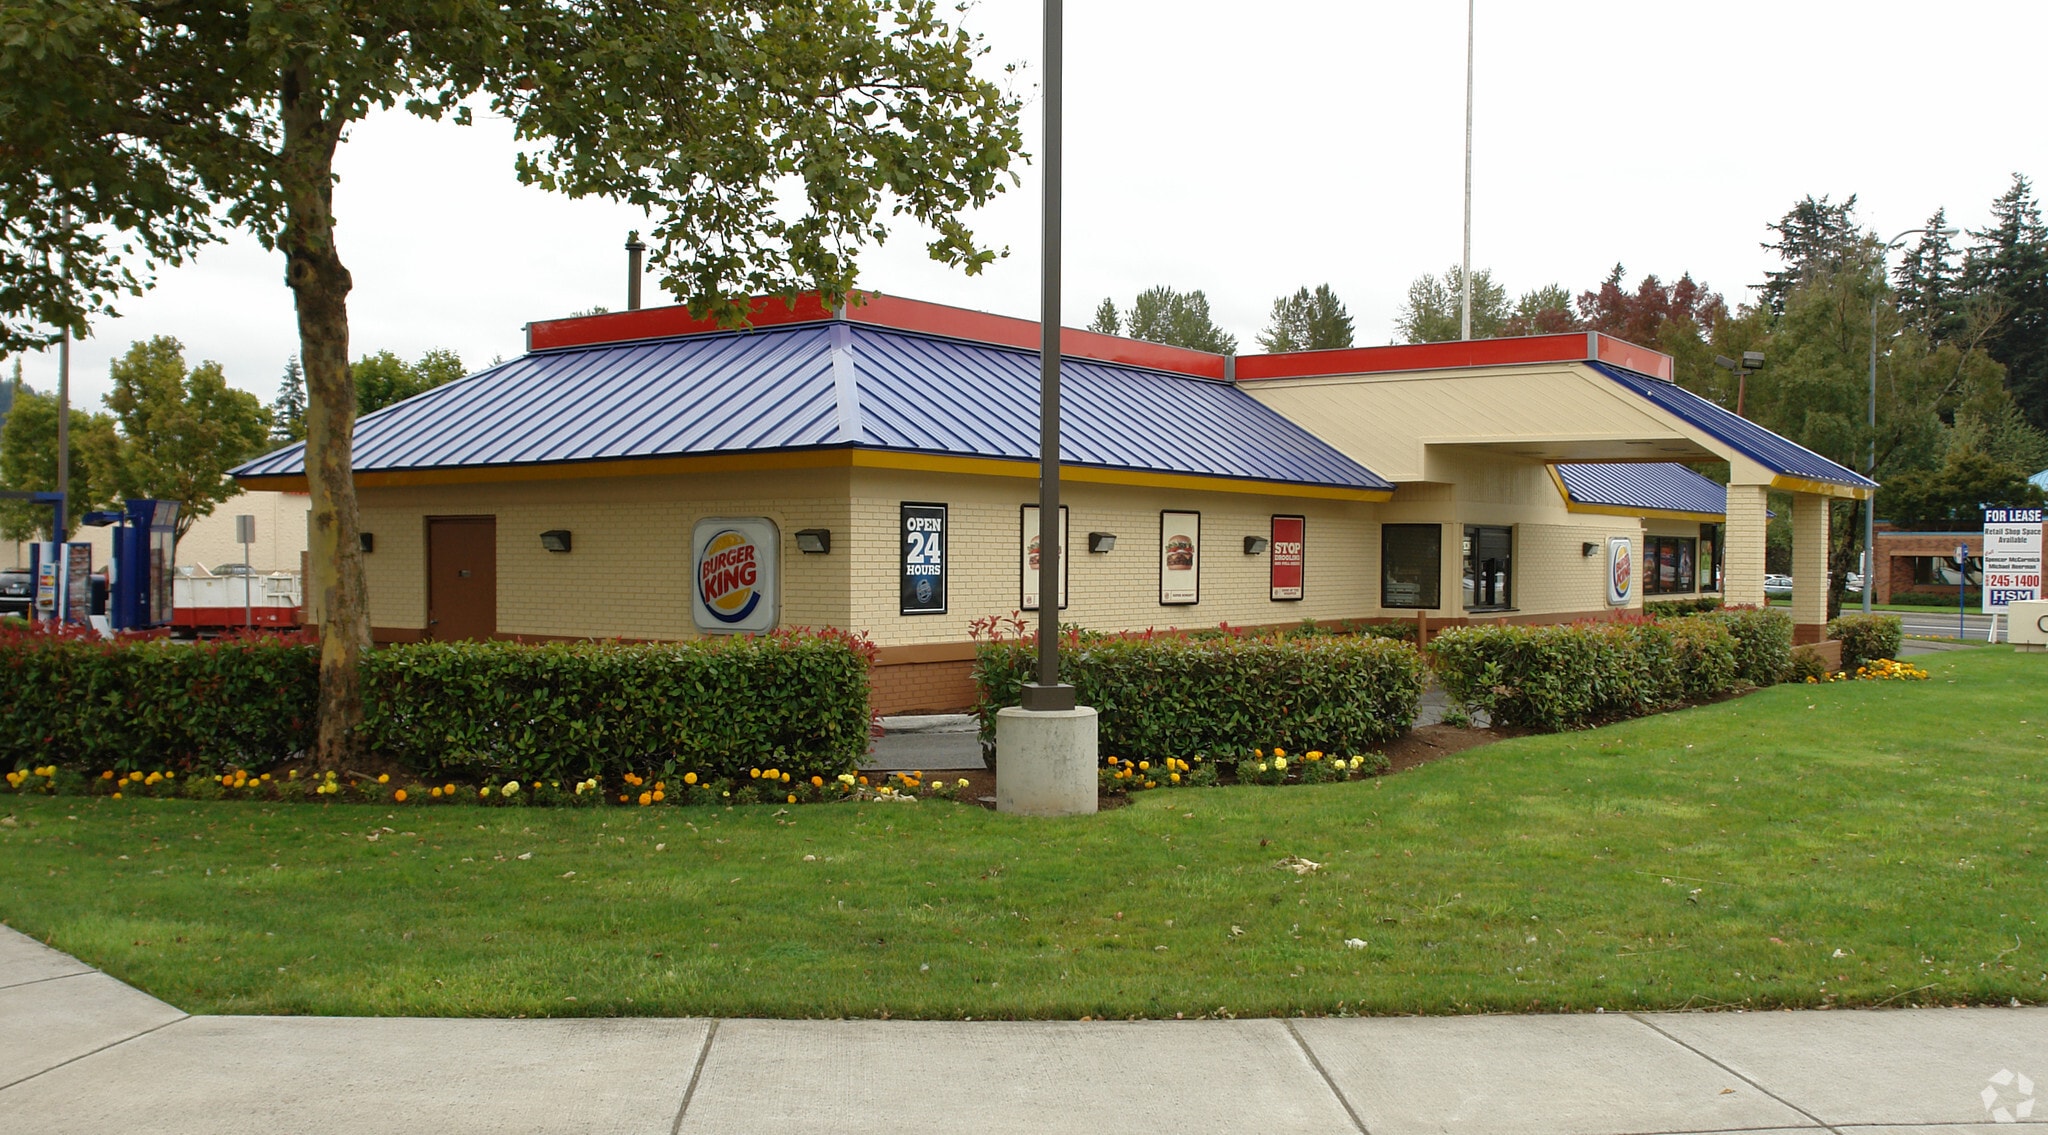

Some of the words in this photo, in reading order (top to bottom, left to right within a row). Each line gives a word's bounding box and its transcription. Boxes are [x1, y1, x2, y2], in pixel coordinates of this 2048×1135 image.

[1985, 510, 2007, 522] FOR
[2009, 510, 2042, 522] LEASE
[906, 517, 942, 532] OPEN
[2005, 528, 2021, 536] Shop
[2022, 528, 2042, 536] Space
[1998, 536, 2028, 544] Available
[907, 532, 941, 563] 24
[1275, 542, 1300, 554] STOP
[702, 545, 755, 580] BURGER
[906, 564, 941, 576] HOURS
[704, 561, 757, 603] KING
[1991, 574, 2040, 587] 245-1400
[1993, 590, 2031, 600] HSM
